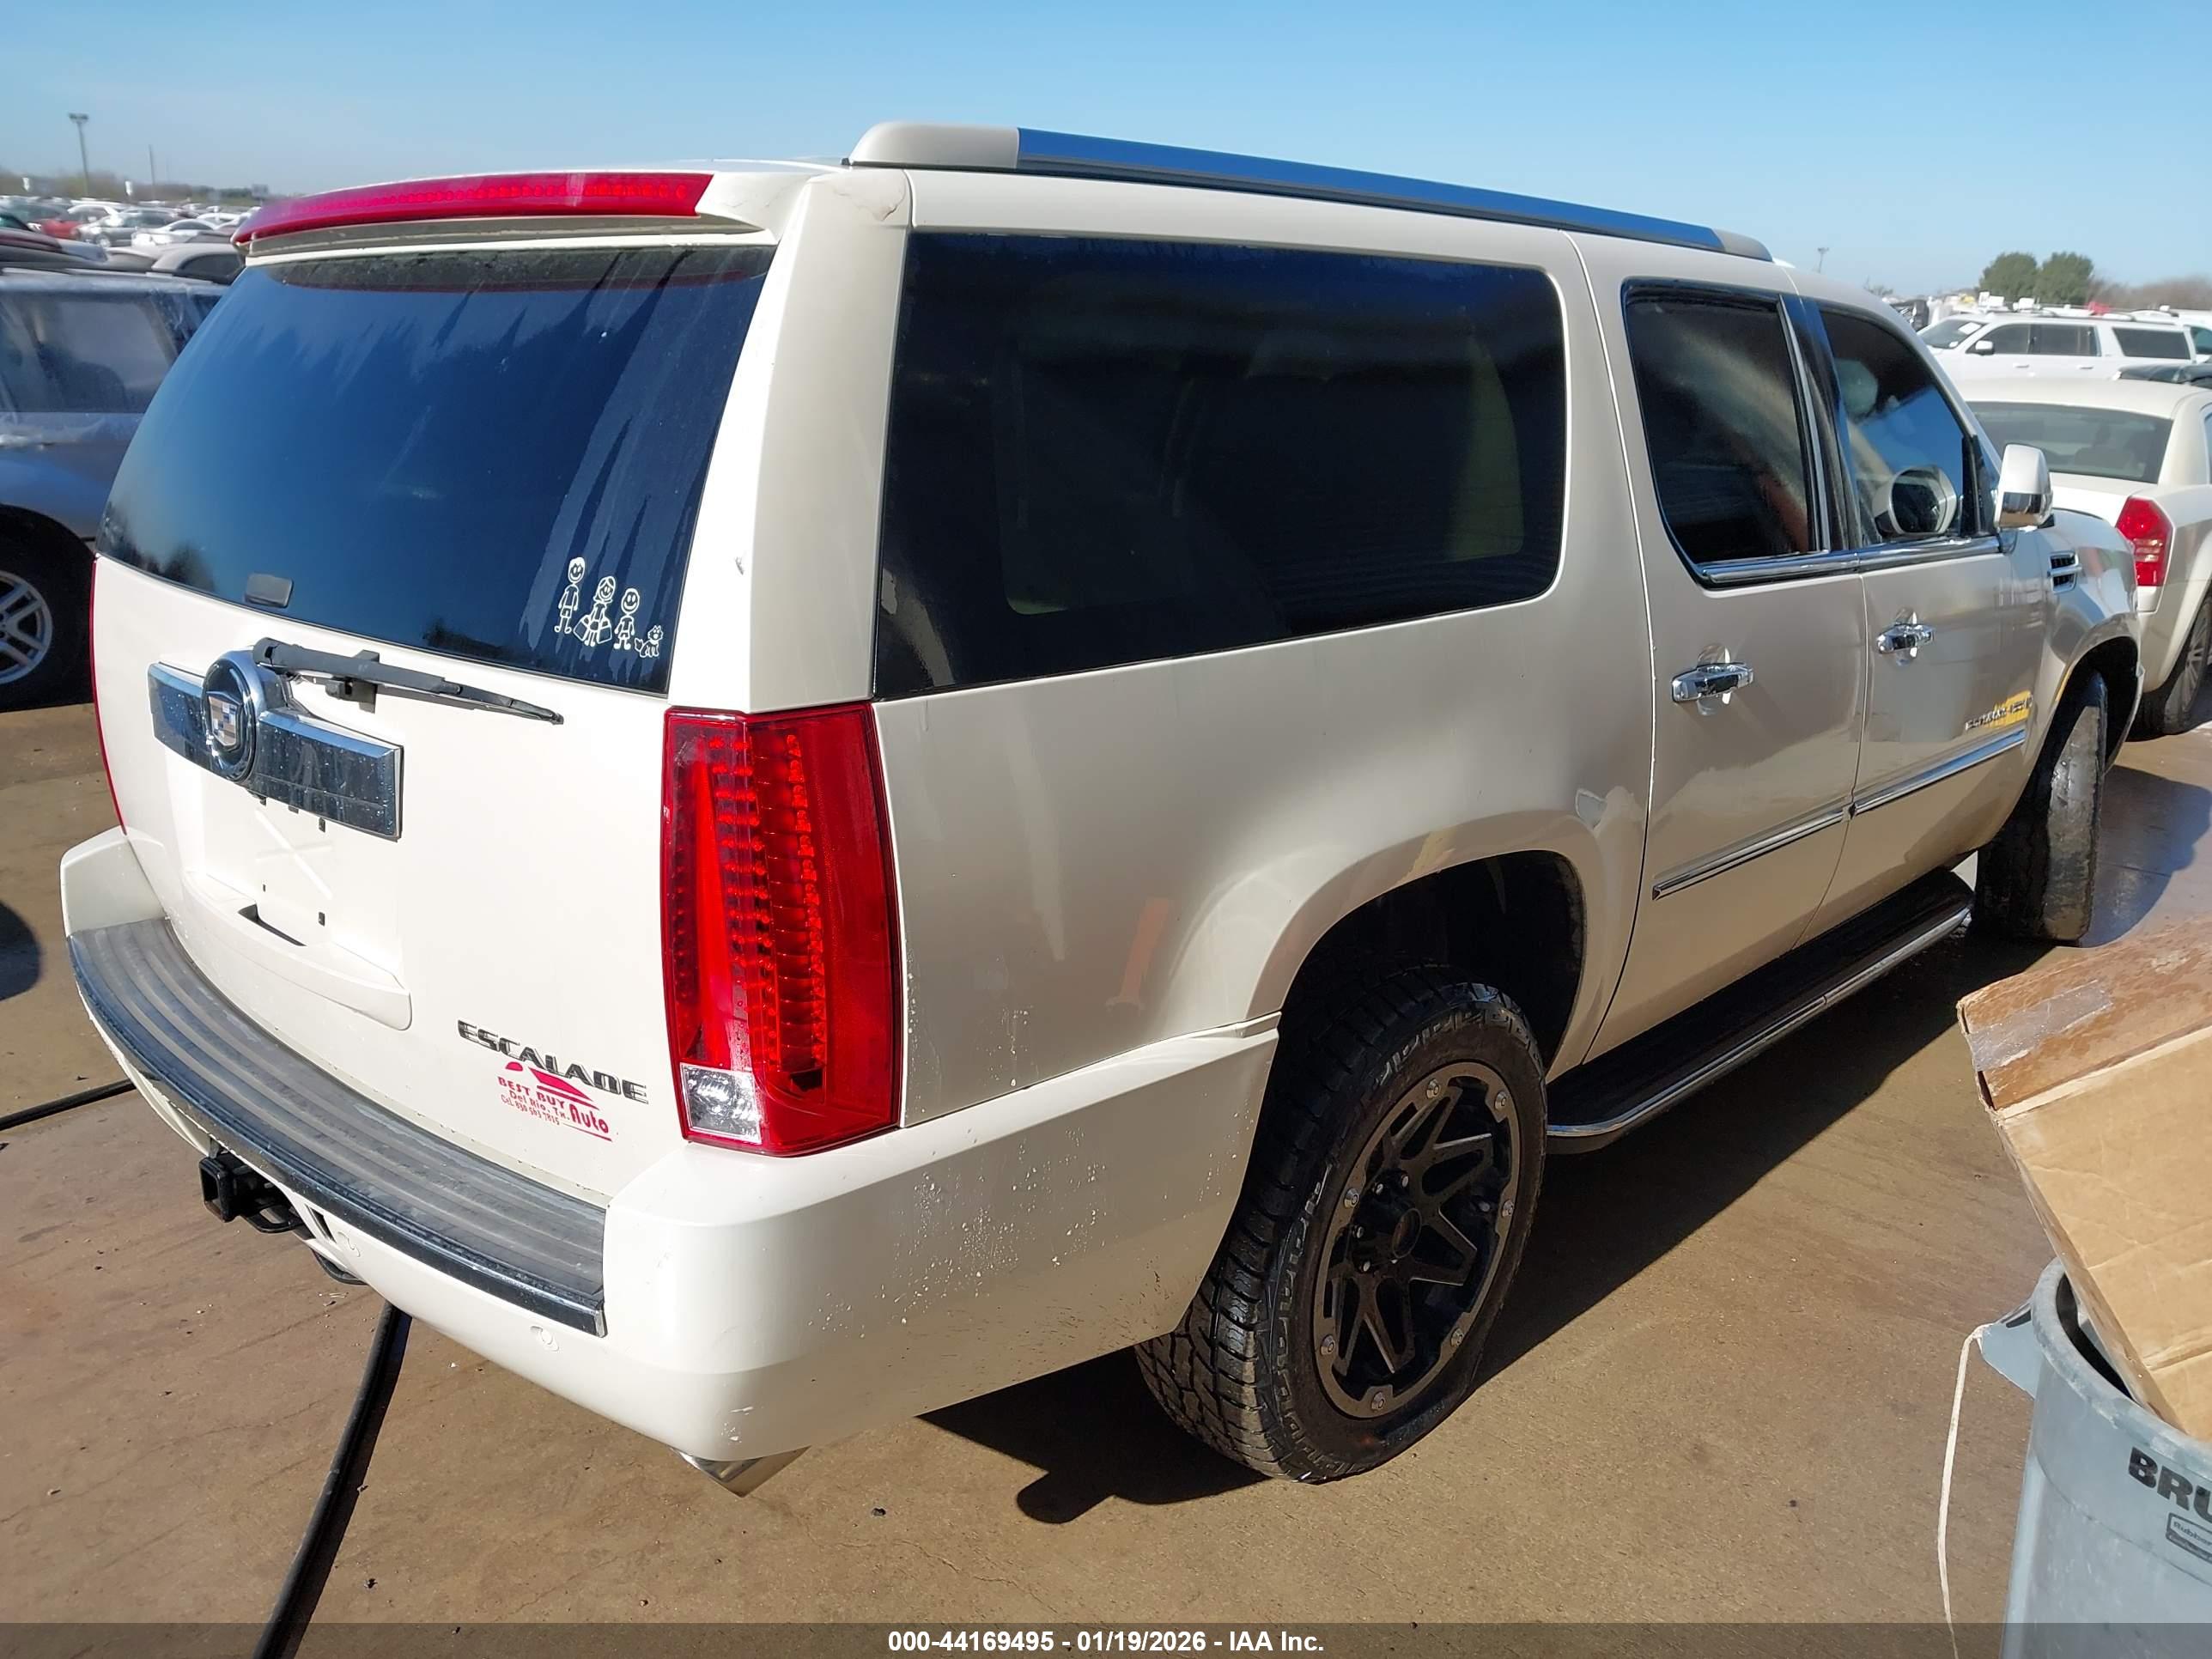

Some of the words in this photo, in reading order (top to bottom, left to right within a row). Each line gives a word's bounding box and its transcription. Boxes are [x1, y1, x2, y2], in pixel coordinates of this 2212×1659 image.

[457, 1019, 649, 1105] ESCALADE
[497, 1076, 531, 1097] BEST
[536, 1091, 565, 1109] BUY
[568, 1103, 609, 1133] Auto
[509, 1090, 527, 1104] Del
